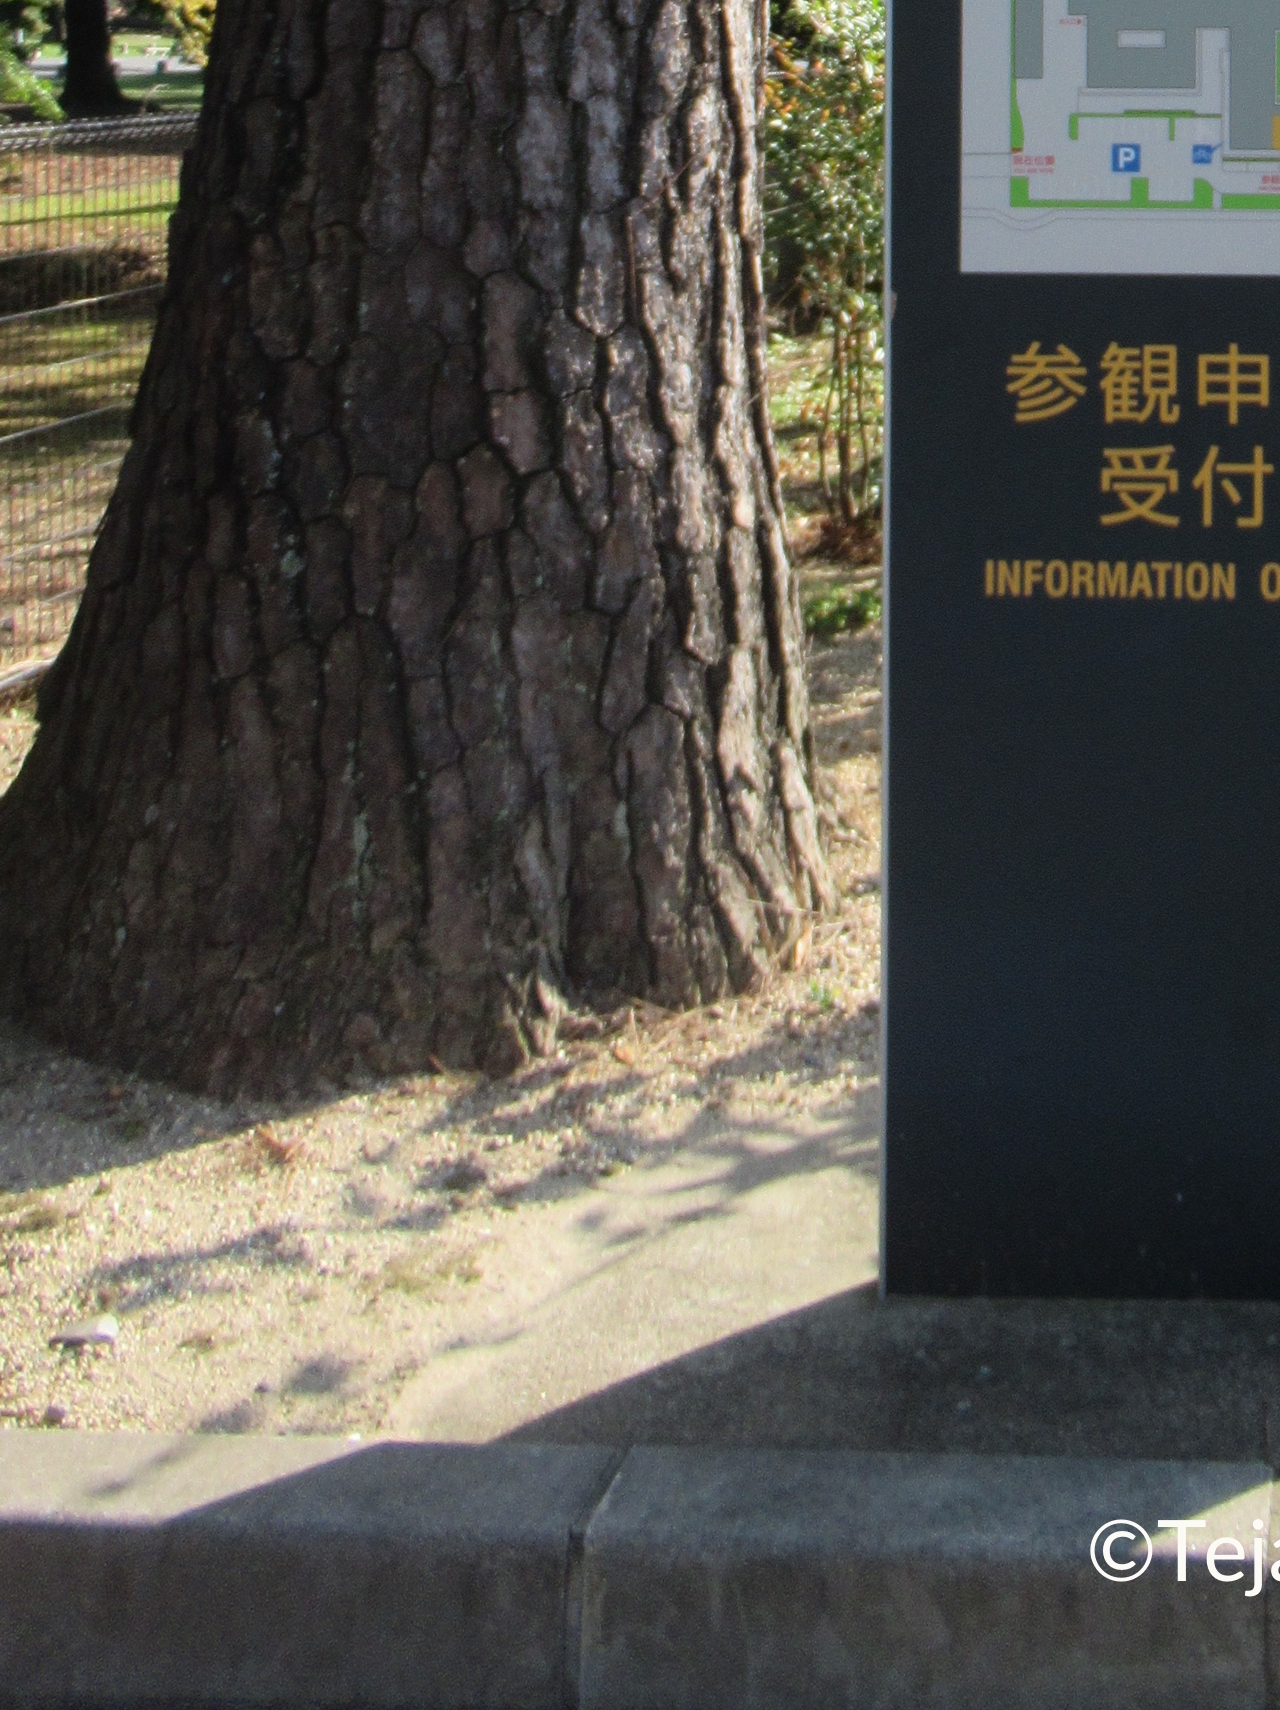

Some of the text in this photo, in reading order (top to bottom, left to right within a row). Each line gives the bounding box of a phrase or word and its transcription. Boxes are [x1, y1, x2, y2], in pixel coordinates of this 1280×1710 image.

[1118, 147, 1136, 169] P
[1100, 444, 1275, 529] 受付
[985, 560, 1237, 602] INFORMATION
